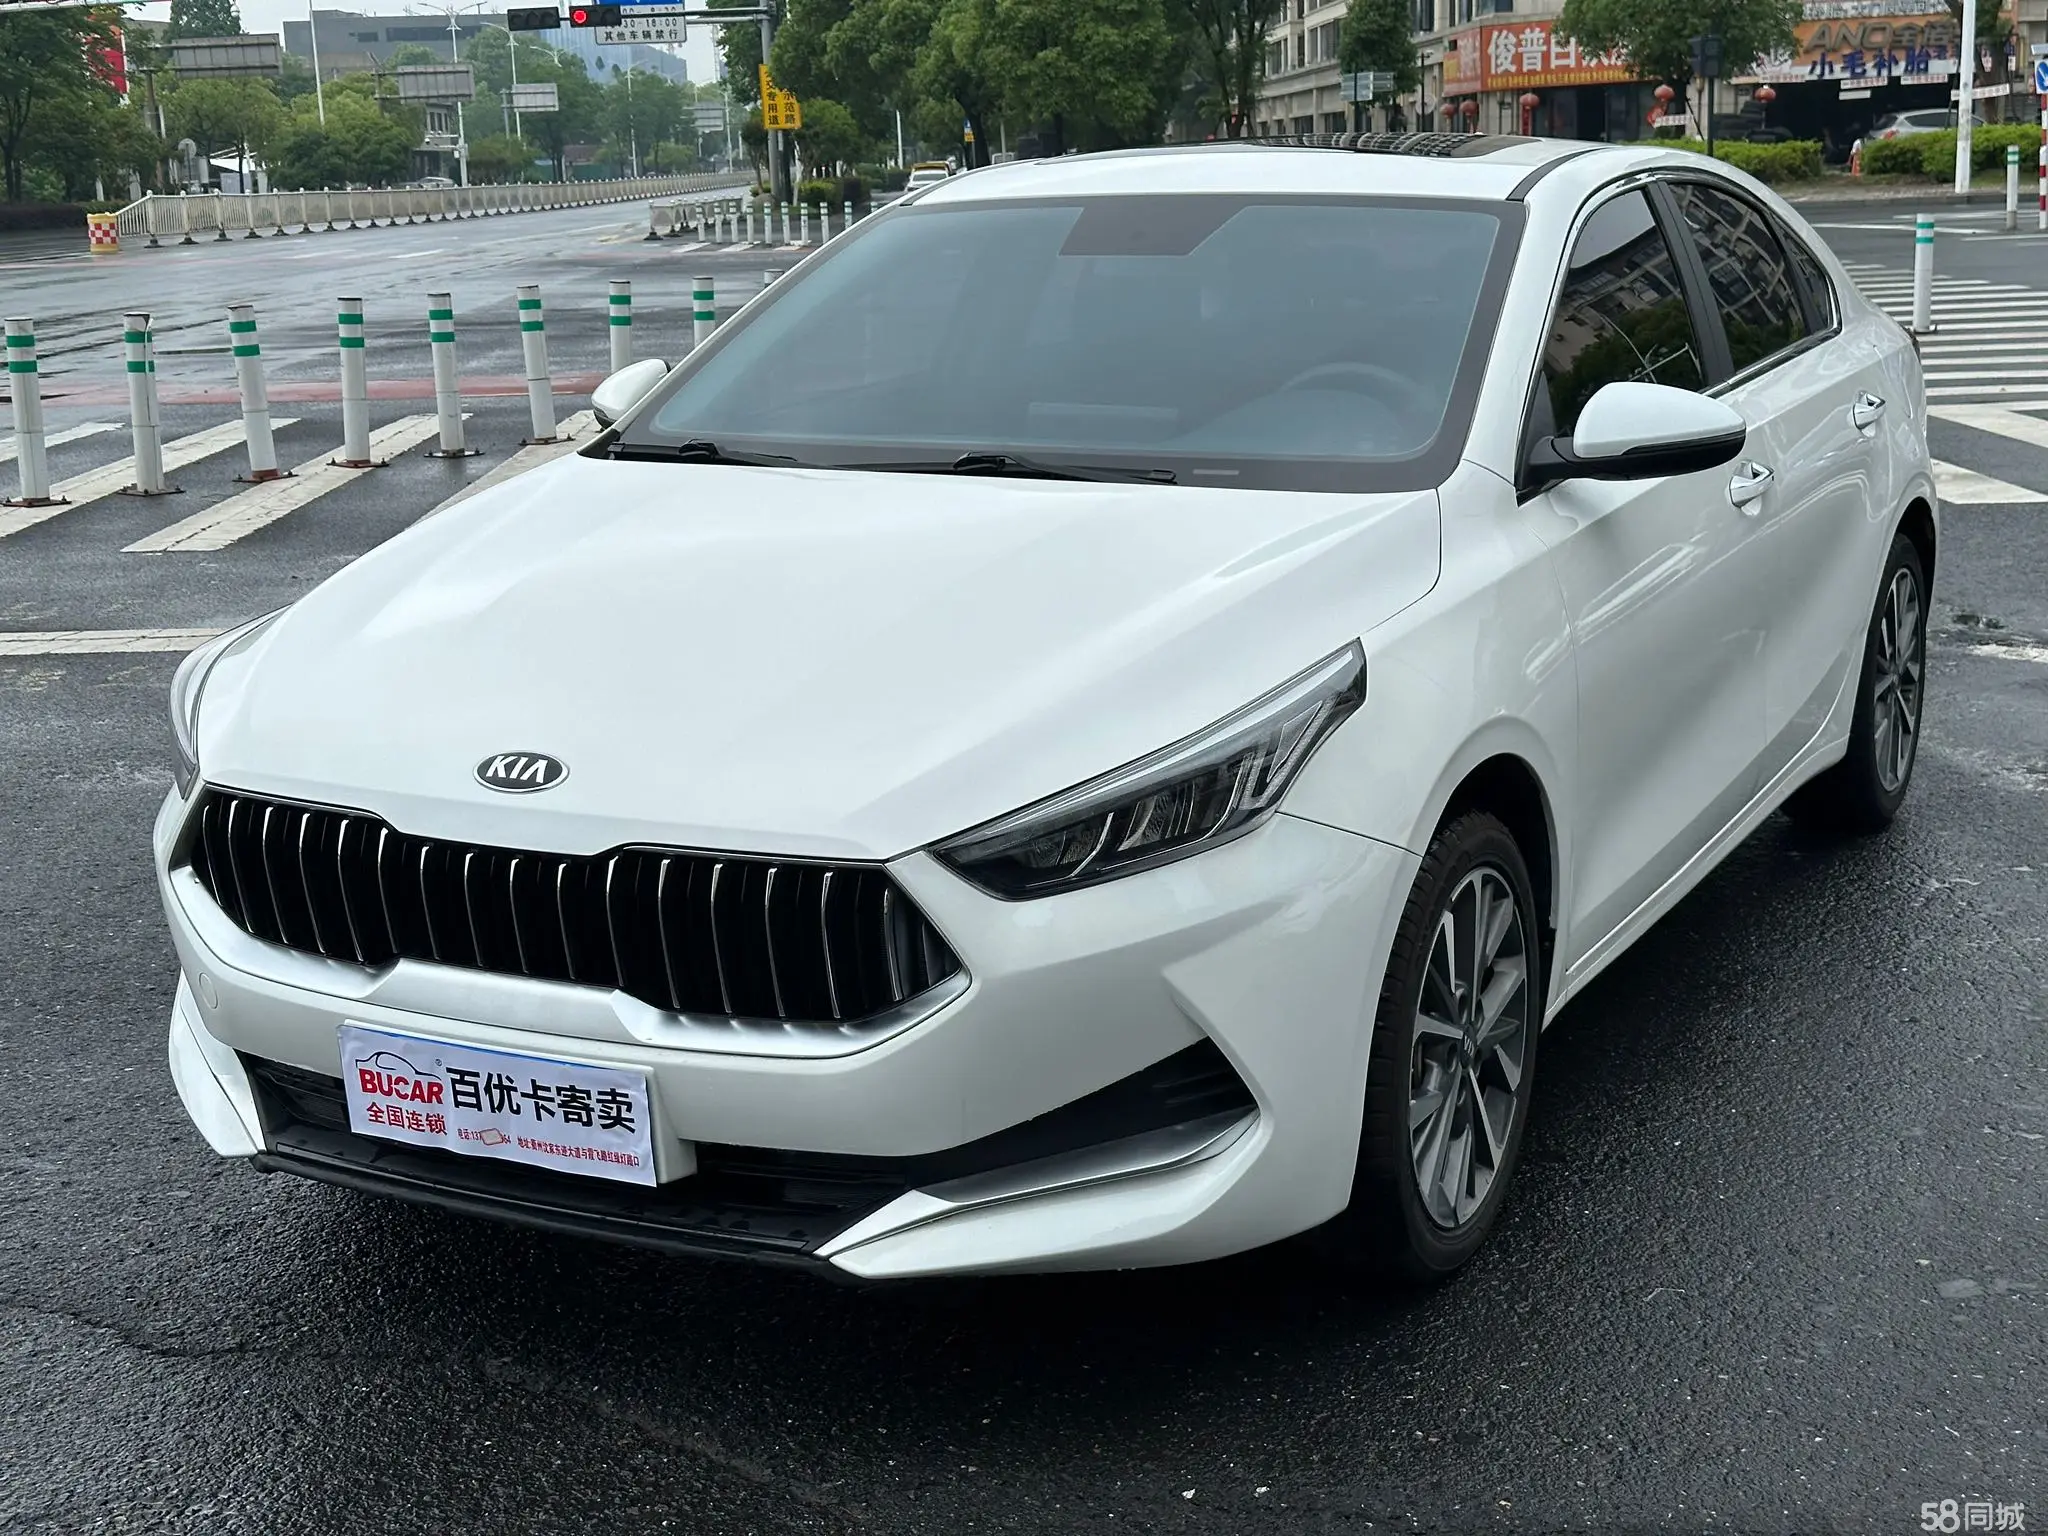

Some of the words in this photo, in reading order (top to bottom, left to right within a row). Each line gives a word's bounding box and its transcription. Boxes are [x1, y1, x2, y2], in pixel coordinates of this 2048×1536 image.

[604, 29, 678, 41] 其他车辆禁行
[1809, 44, 1931, 79] 小毛补胎
[485, 755, 548, 783] KIA
[358, 1068, 445, 1105] BUCAR
[446, 1066, 636, 1134] 百优卡寄卖
[366, 1101, 448, 1136] 全国连锁
